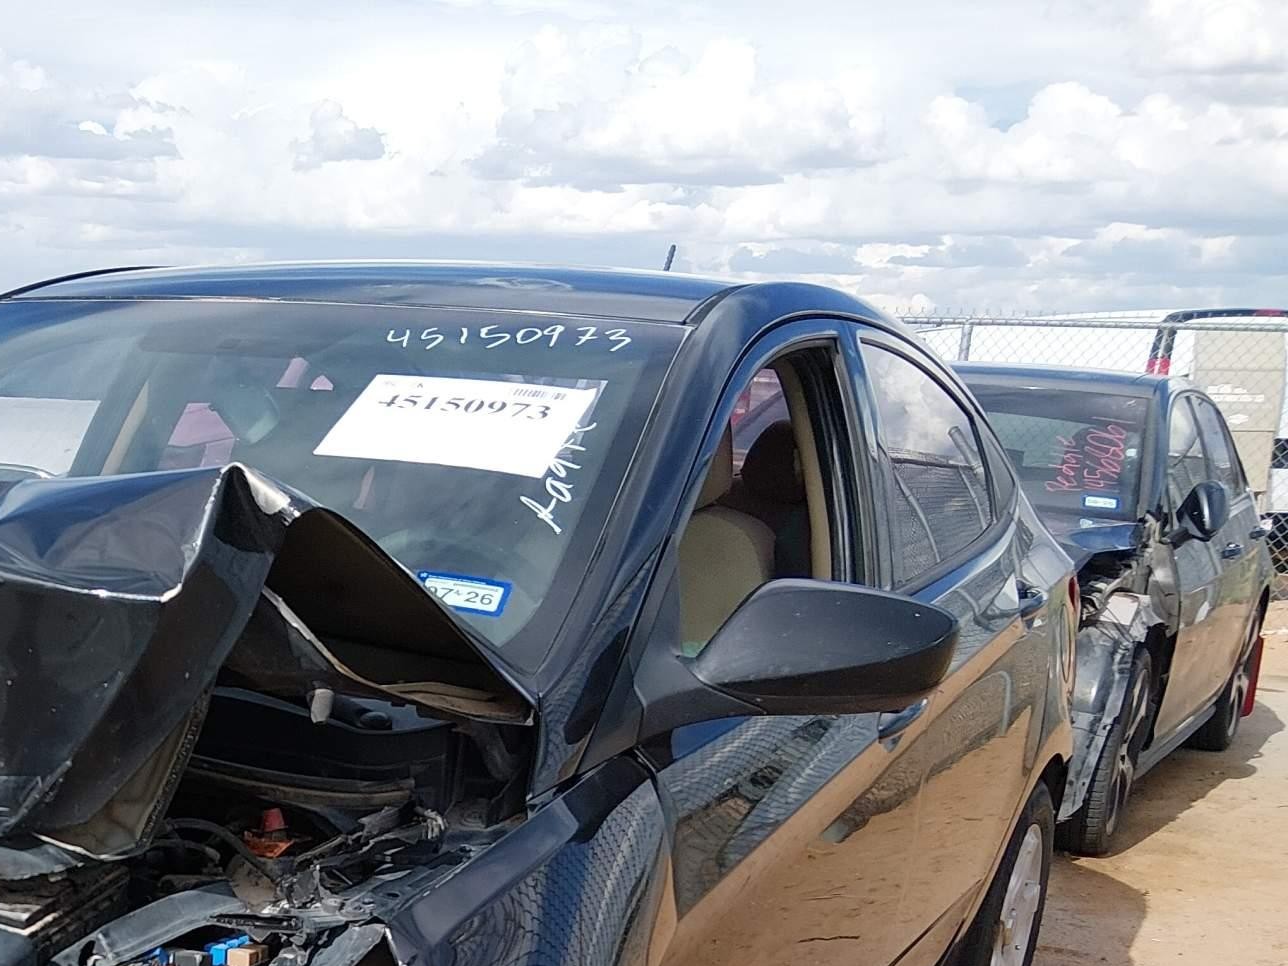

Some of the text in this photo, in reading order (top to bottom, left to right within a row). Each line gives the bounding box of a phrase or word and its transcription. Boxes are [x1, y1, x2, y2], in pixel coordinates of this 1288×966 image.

[386, 325, 632, 352] 45150973
[377, 394, 553, 420] 45150973
[464, 591, 494, 606] 26
